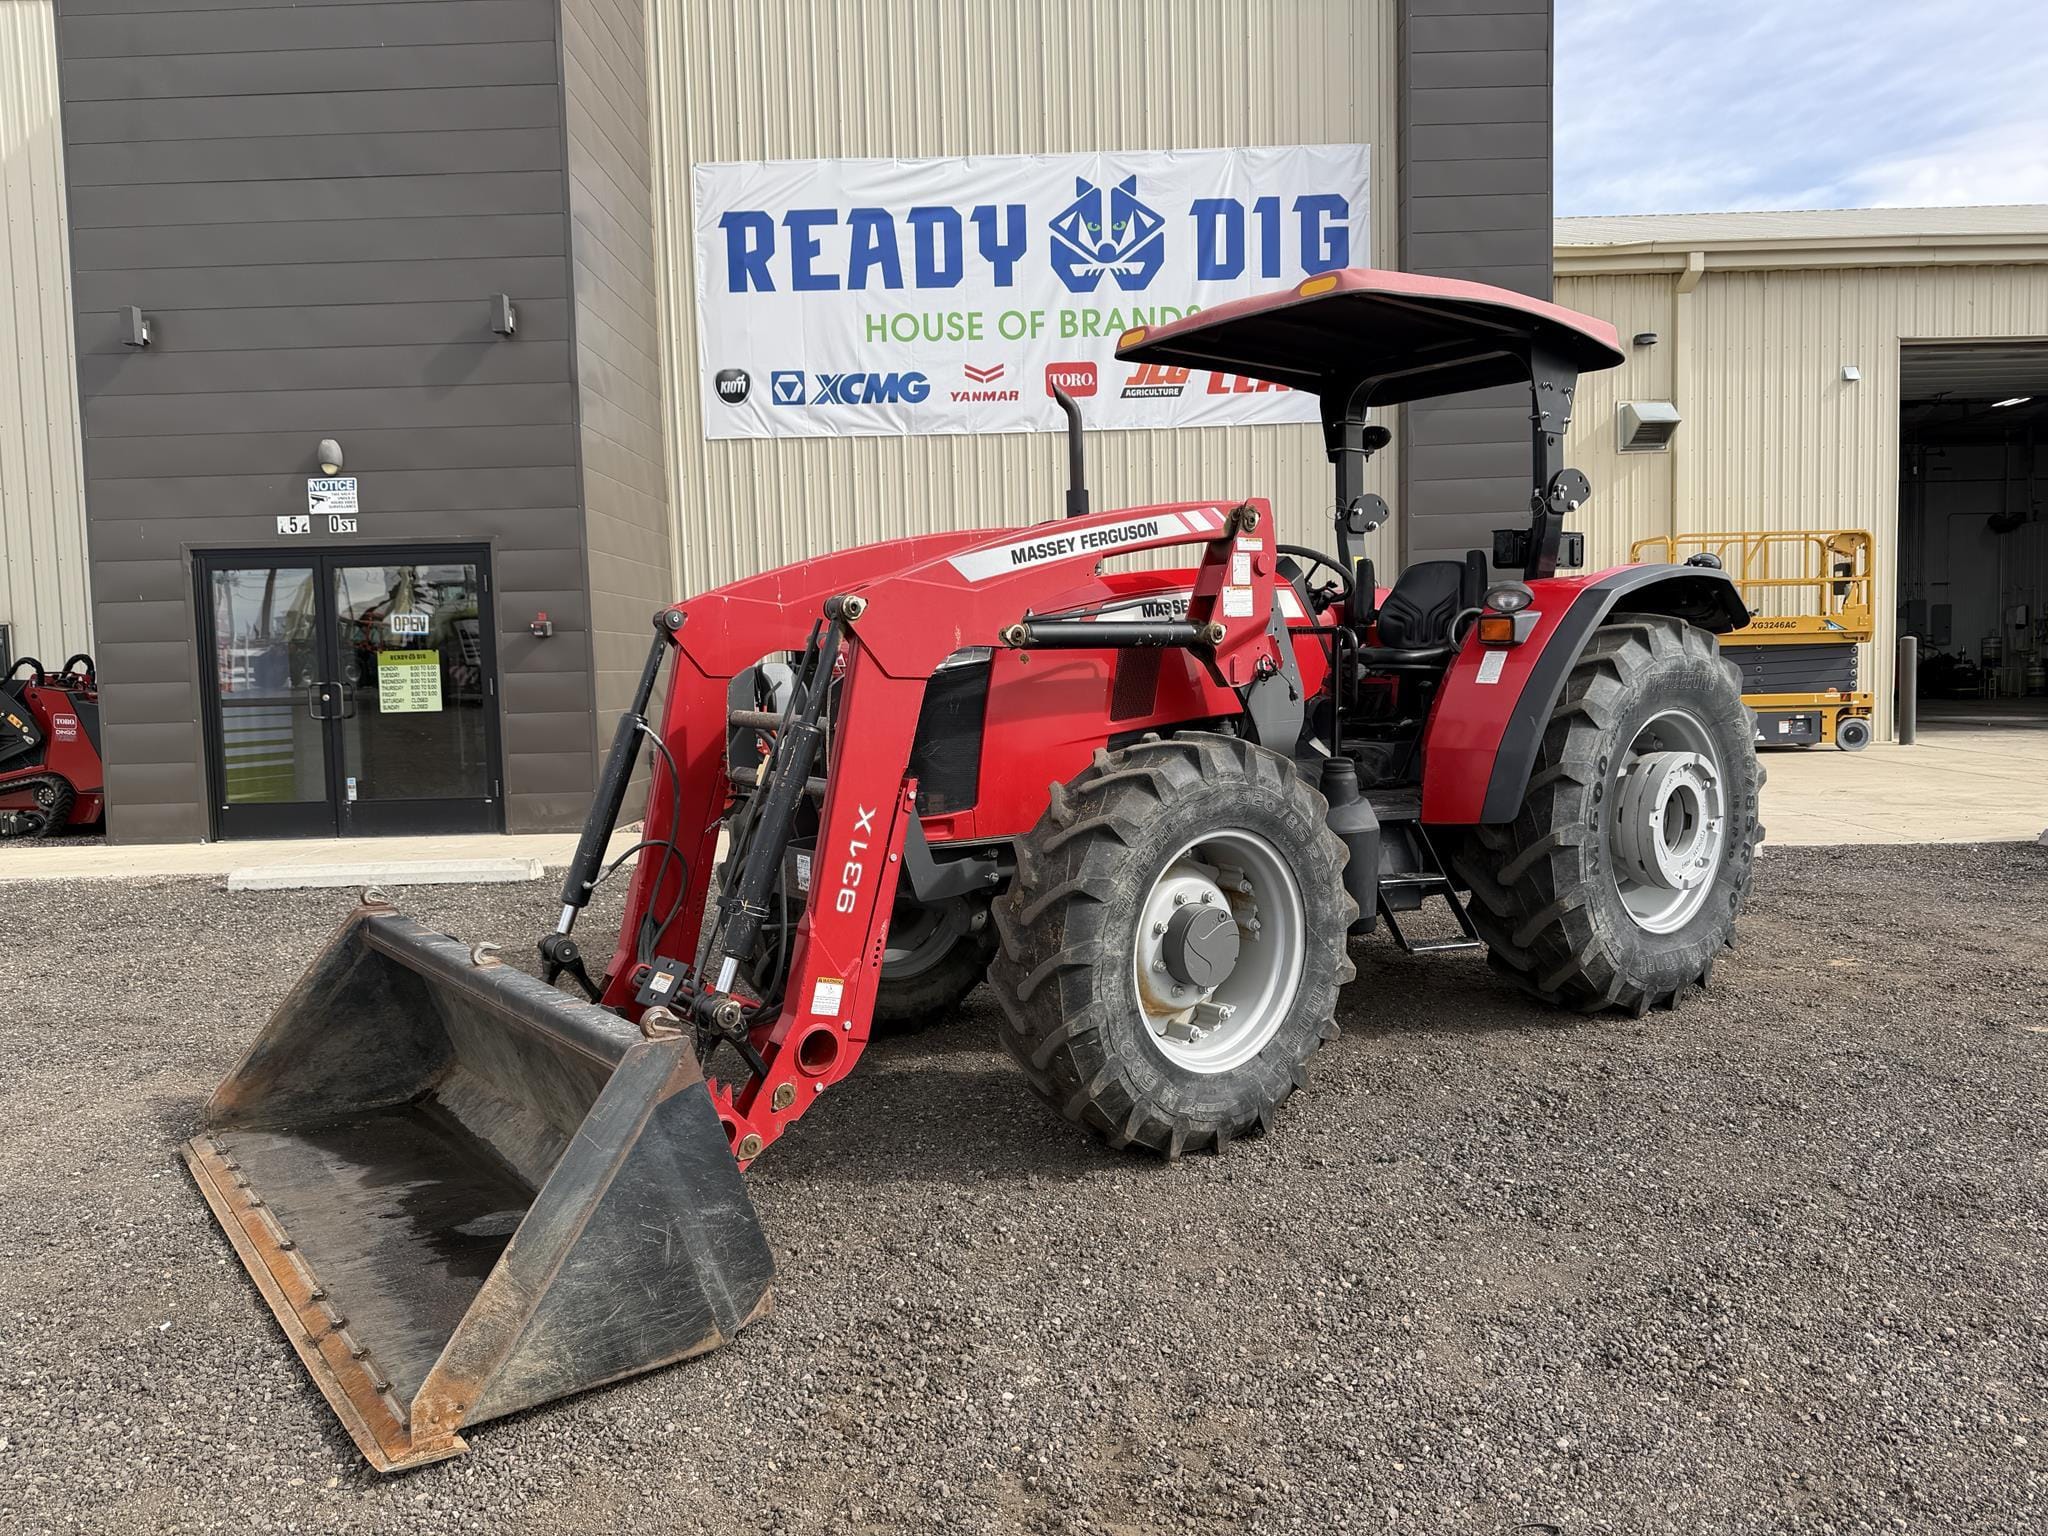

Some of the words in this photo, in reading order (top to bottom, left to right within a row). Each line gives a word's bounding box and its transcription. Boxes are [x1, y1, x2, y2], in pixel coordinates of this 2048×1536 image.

[718, 203, 1027, 293] READY
[1189, 193, 1349, 281] DIG
[865, 311, 984, 343] HOUSE
[998, 309, 1045, 341] OF
[1049, 372, 1093, 387] TORO
[810, 371, 931, 405] XCMG
[950, 390, 1019, 402] YANMAR
[1125, 387, 1180, 398] AGRICULTURE
[310, 480, 354, 491] NOTICE
[1011, 537, 1075, 565] MASSEY
[1080, 521, 1159, 550] FERGUSON
[1142, 599, 1189, 618] MASSE
[393, 616, 426, 632] OPEN
[1751, 621, 1797, 629] XG3246AC
